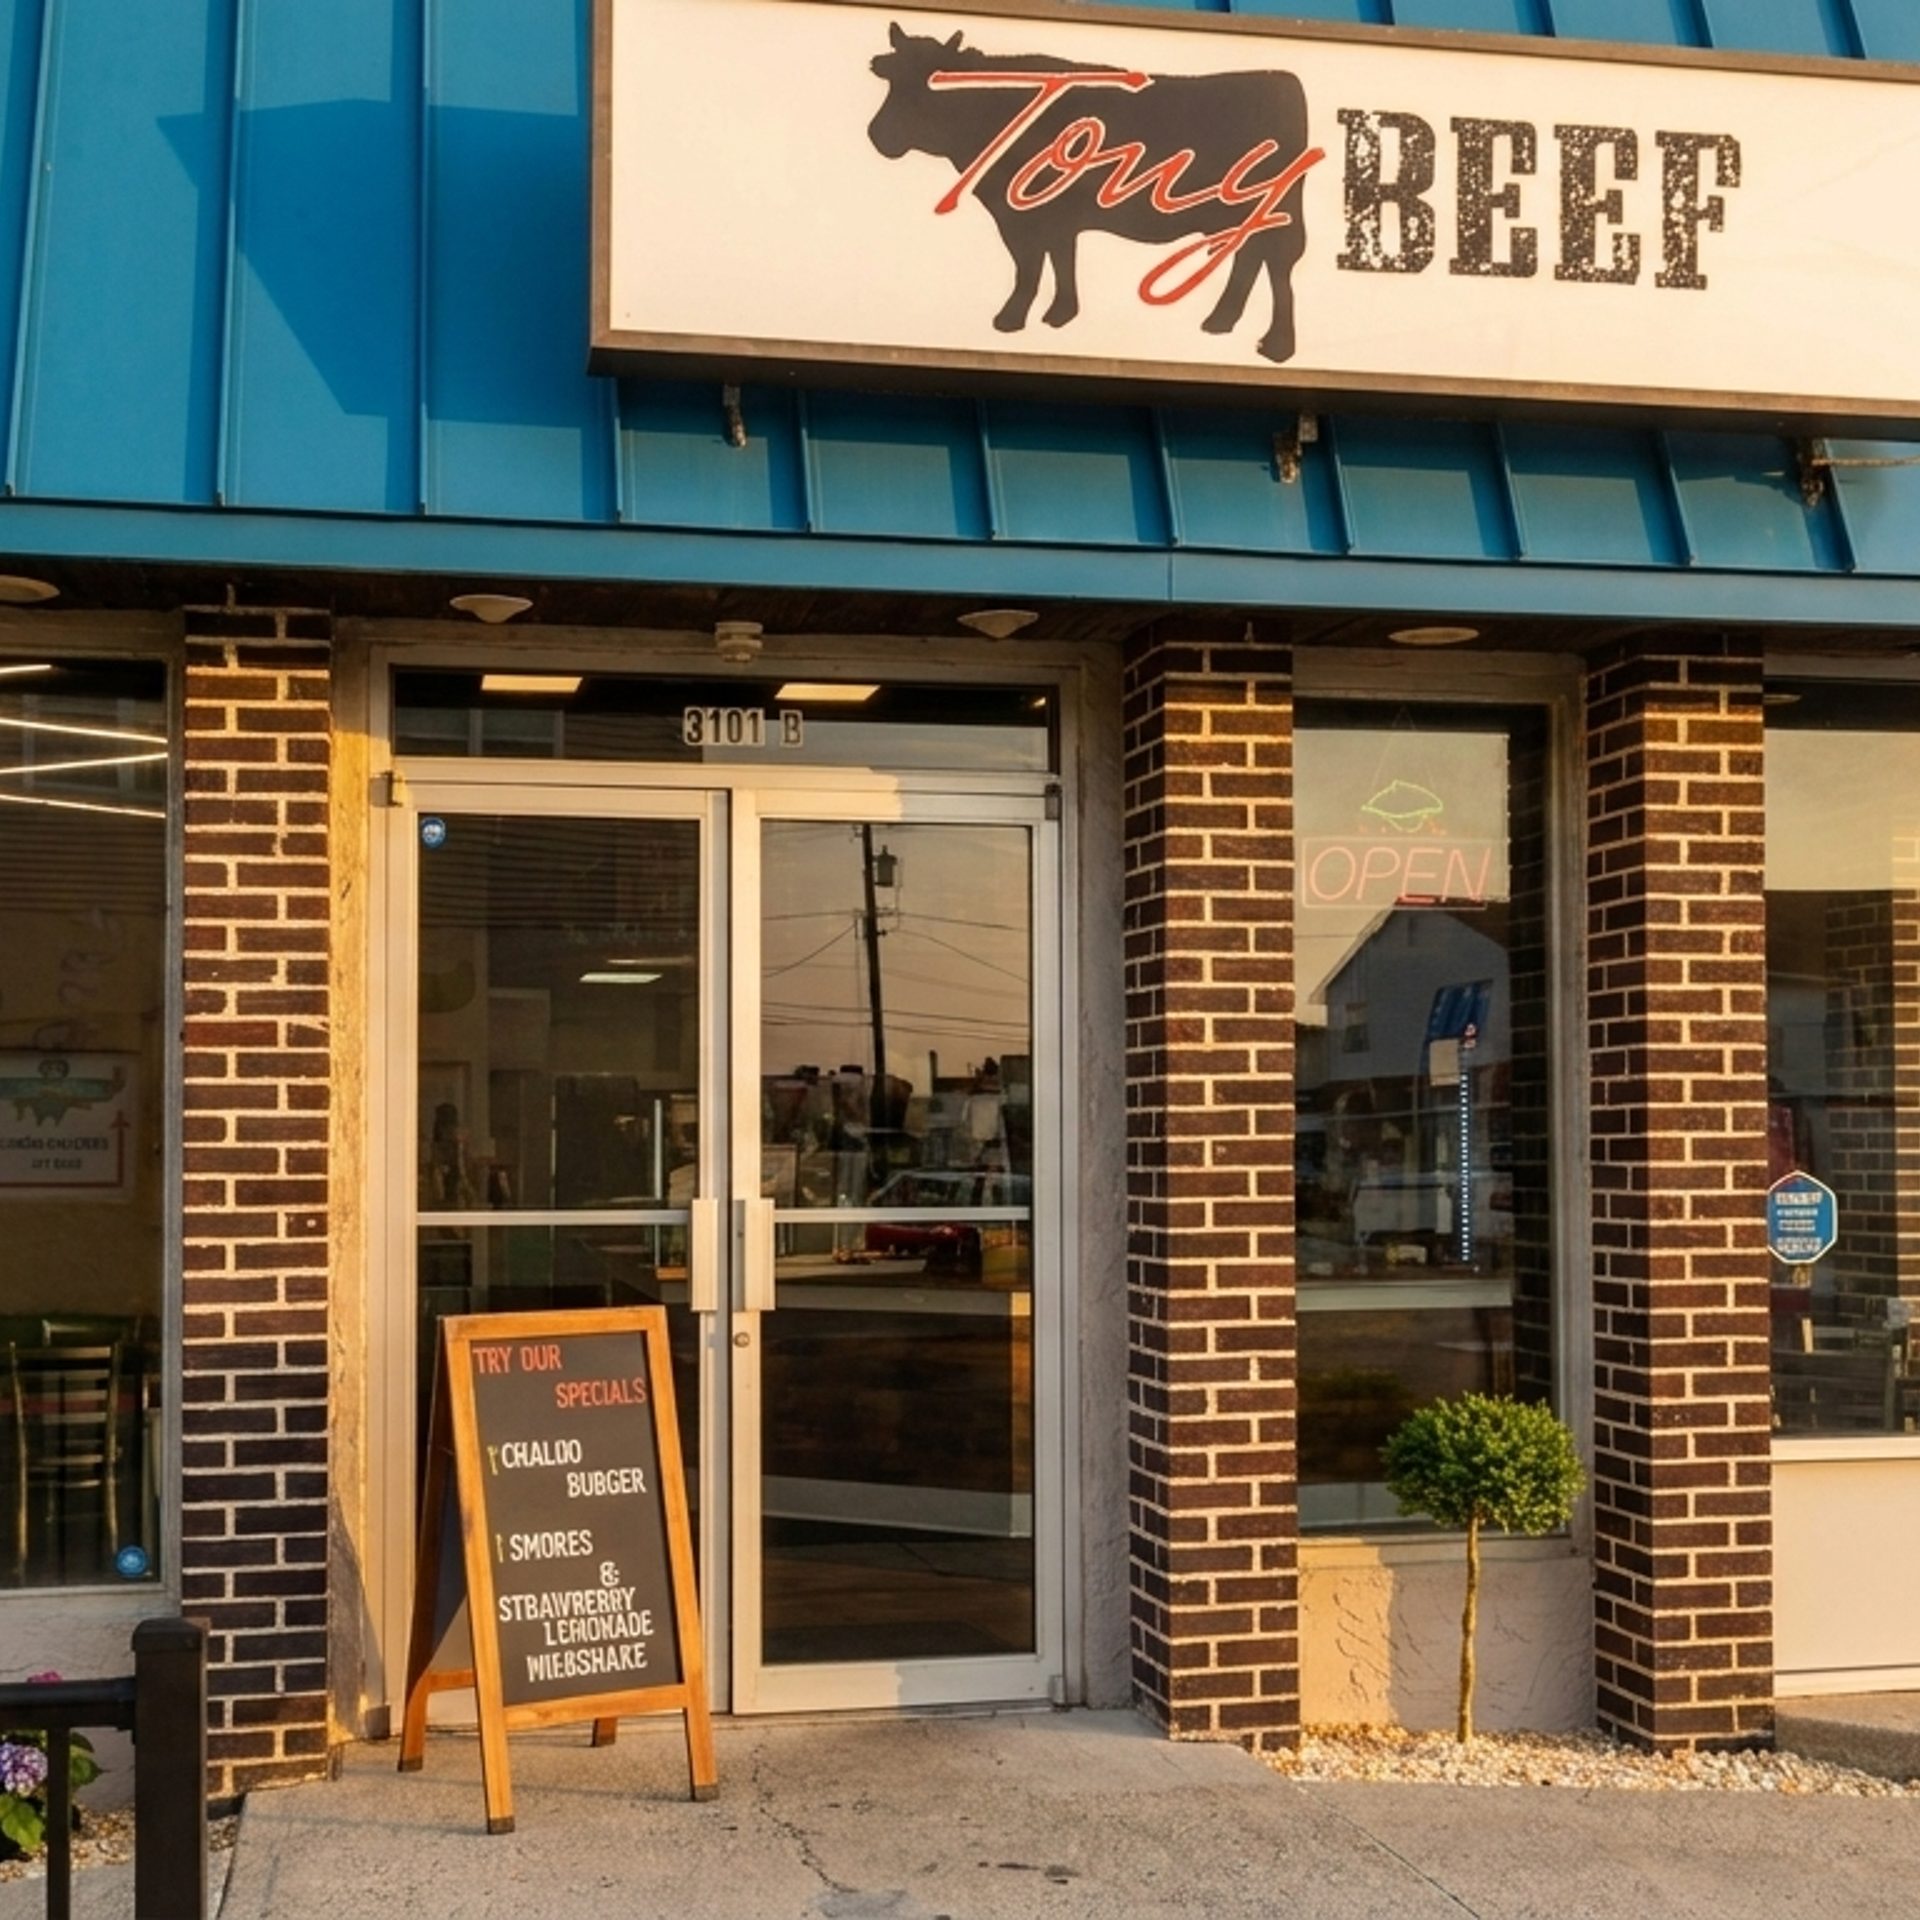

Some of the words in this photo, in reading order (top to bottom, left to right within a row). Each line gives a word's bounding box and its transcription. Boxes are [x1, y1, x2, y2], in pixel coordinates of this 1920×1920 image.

[931, 70, 1325, 306] Tony
[1336, 107, 1742, 290] BEEF
[687, 709, 759, 743] 3101
[784, 712, 801, 743] B
[1309, 846, 1491, 903] OPEN
[473, 1346, 512, 1374] TRY
[521, 1344, 562, 1372] OUR
[555, 1377, 647, 1409] SPECIALS
[509, 1530, 594, 1561] SMORES
